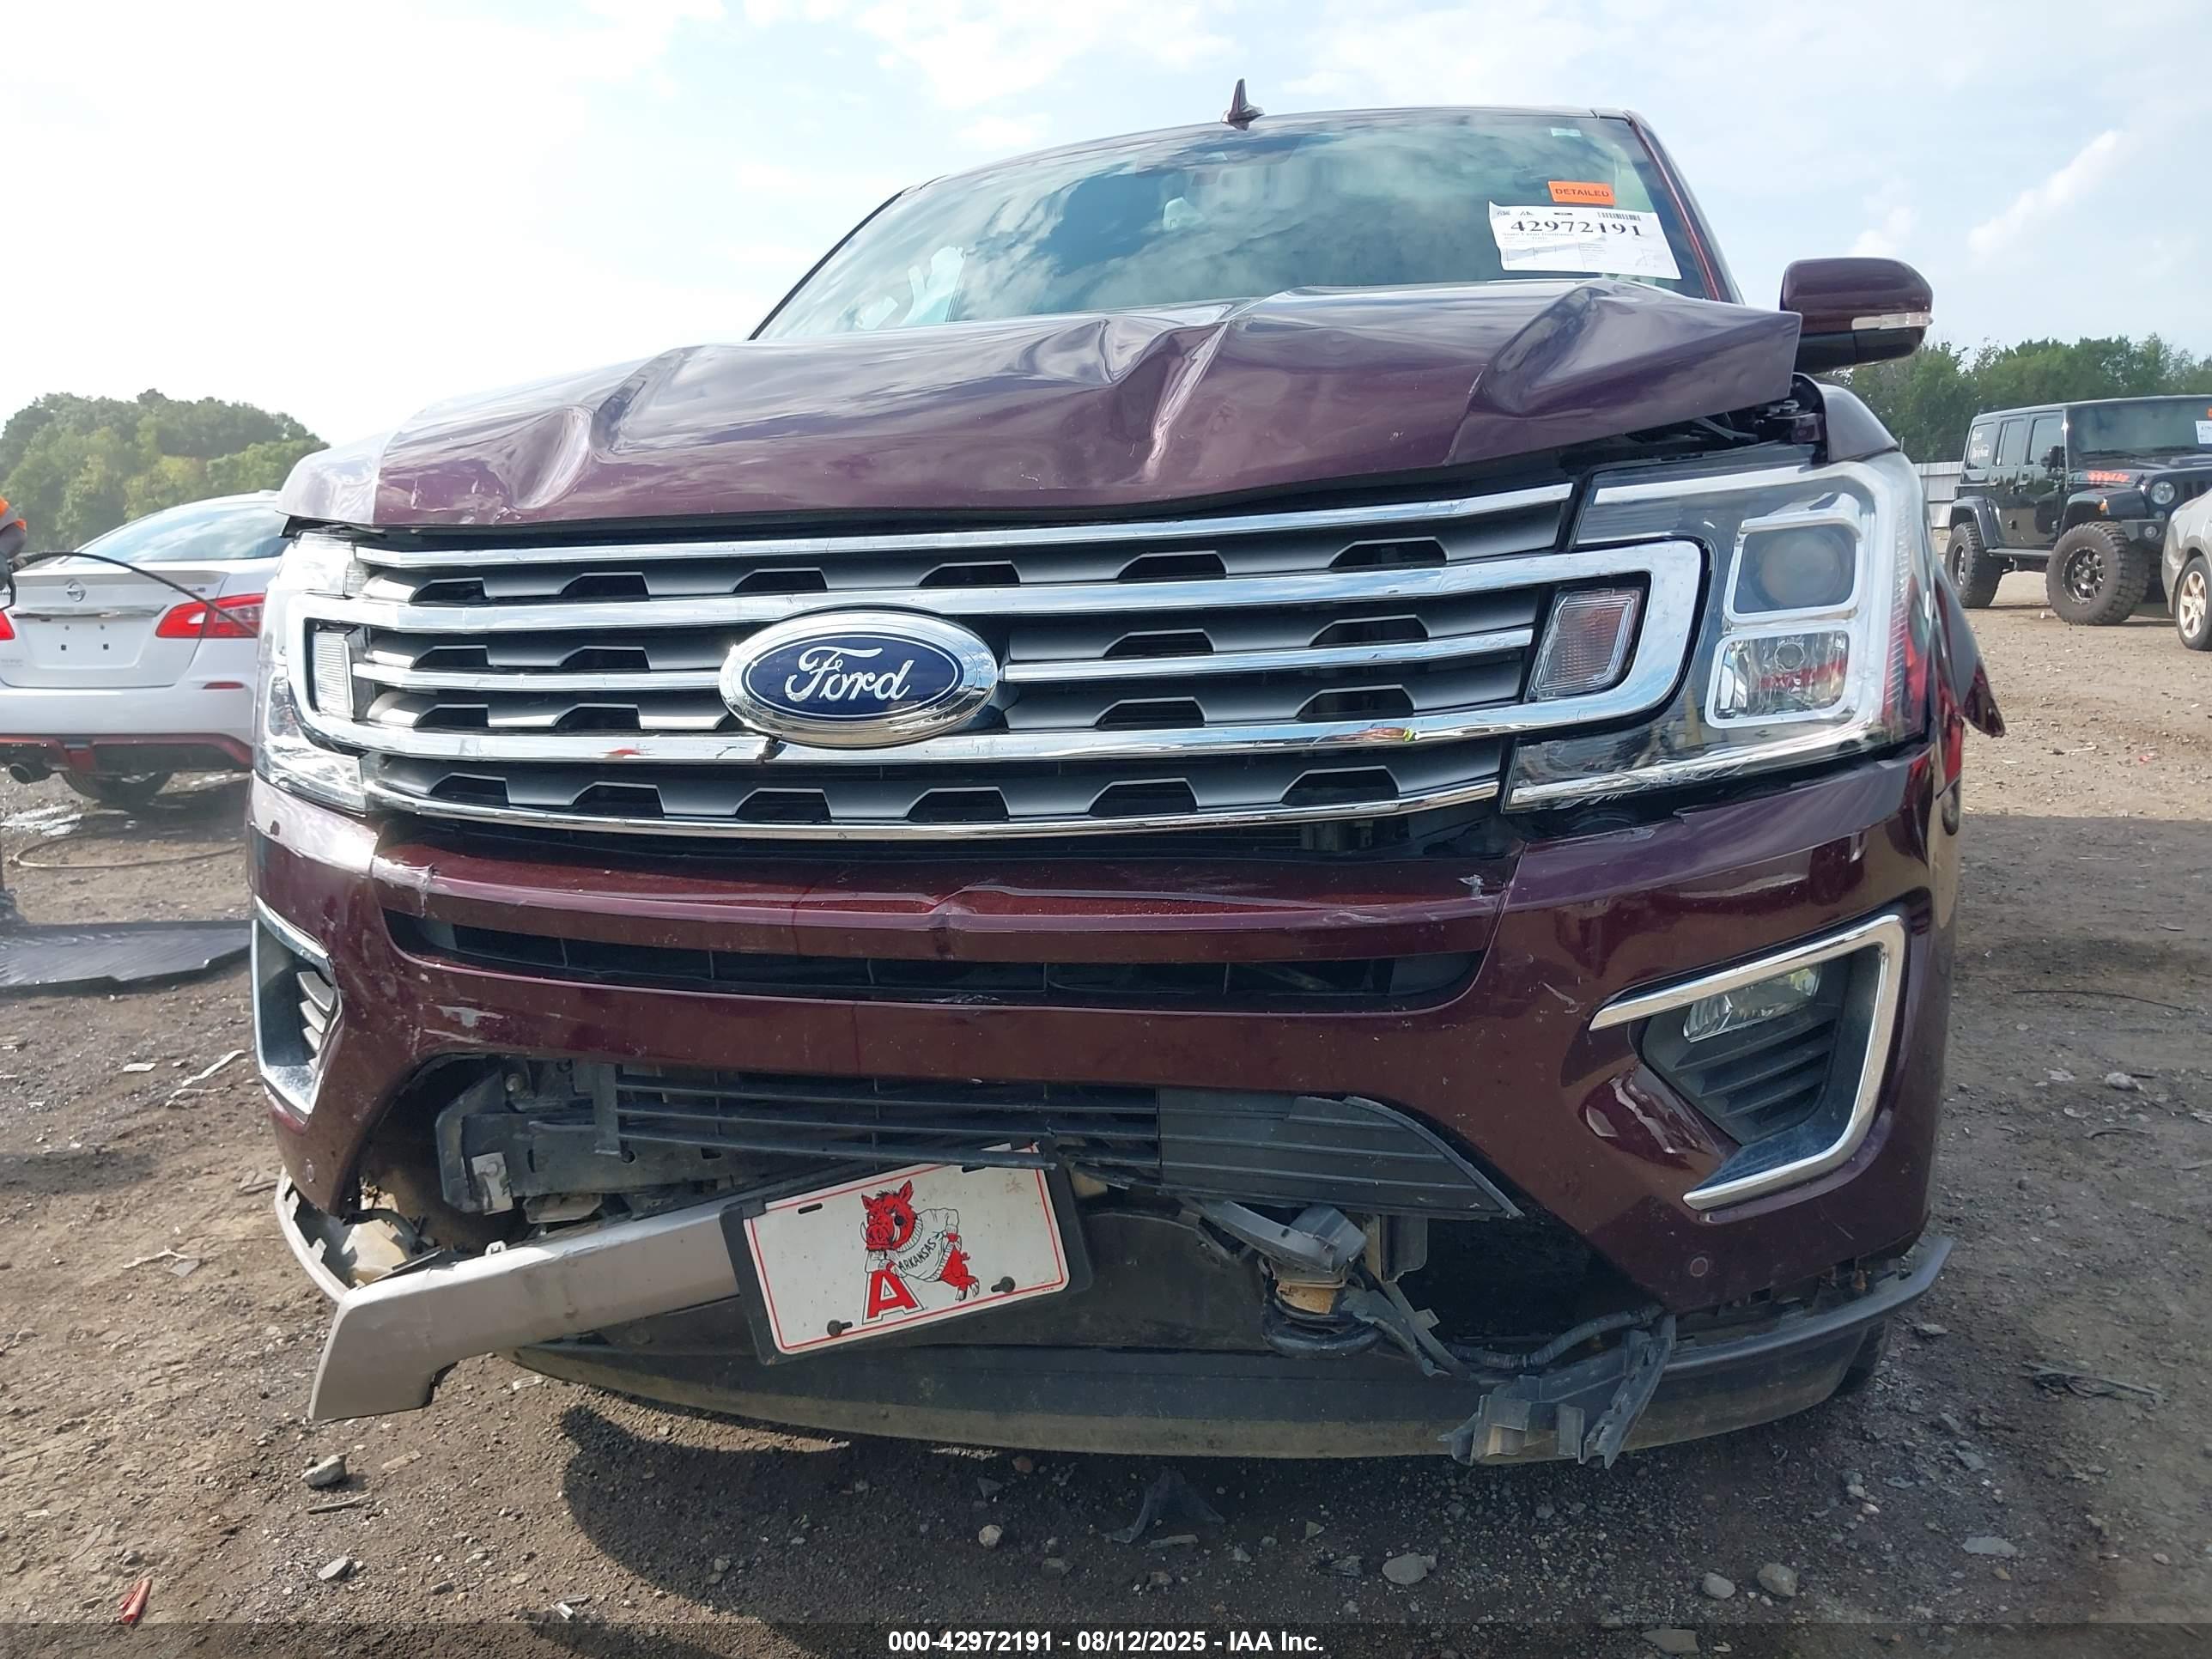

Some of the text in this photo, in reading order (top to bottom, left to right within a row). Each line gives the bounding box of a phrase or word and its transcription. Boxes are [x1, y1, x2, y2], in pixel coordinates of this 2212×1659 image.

[1555, 188, 1609, 198] DETAILED
[1510, 220, 1643, 237] 42972191
[784, 646, 915, 702] Ford
[898, 1237, 937, 1271] ARKANSAS
[863, 1270, 923, 1324] A
